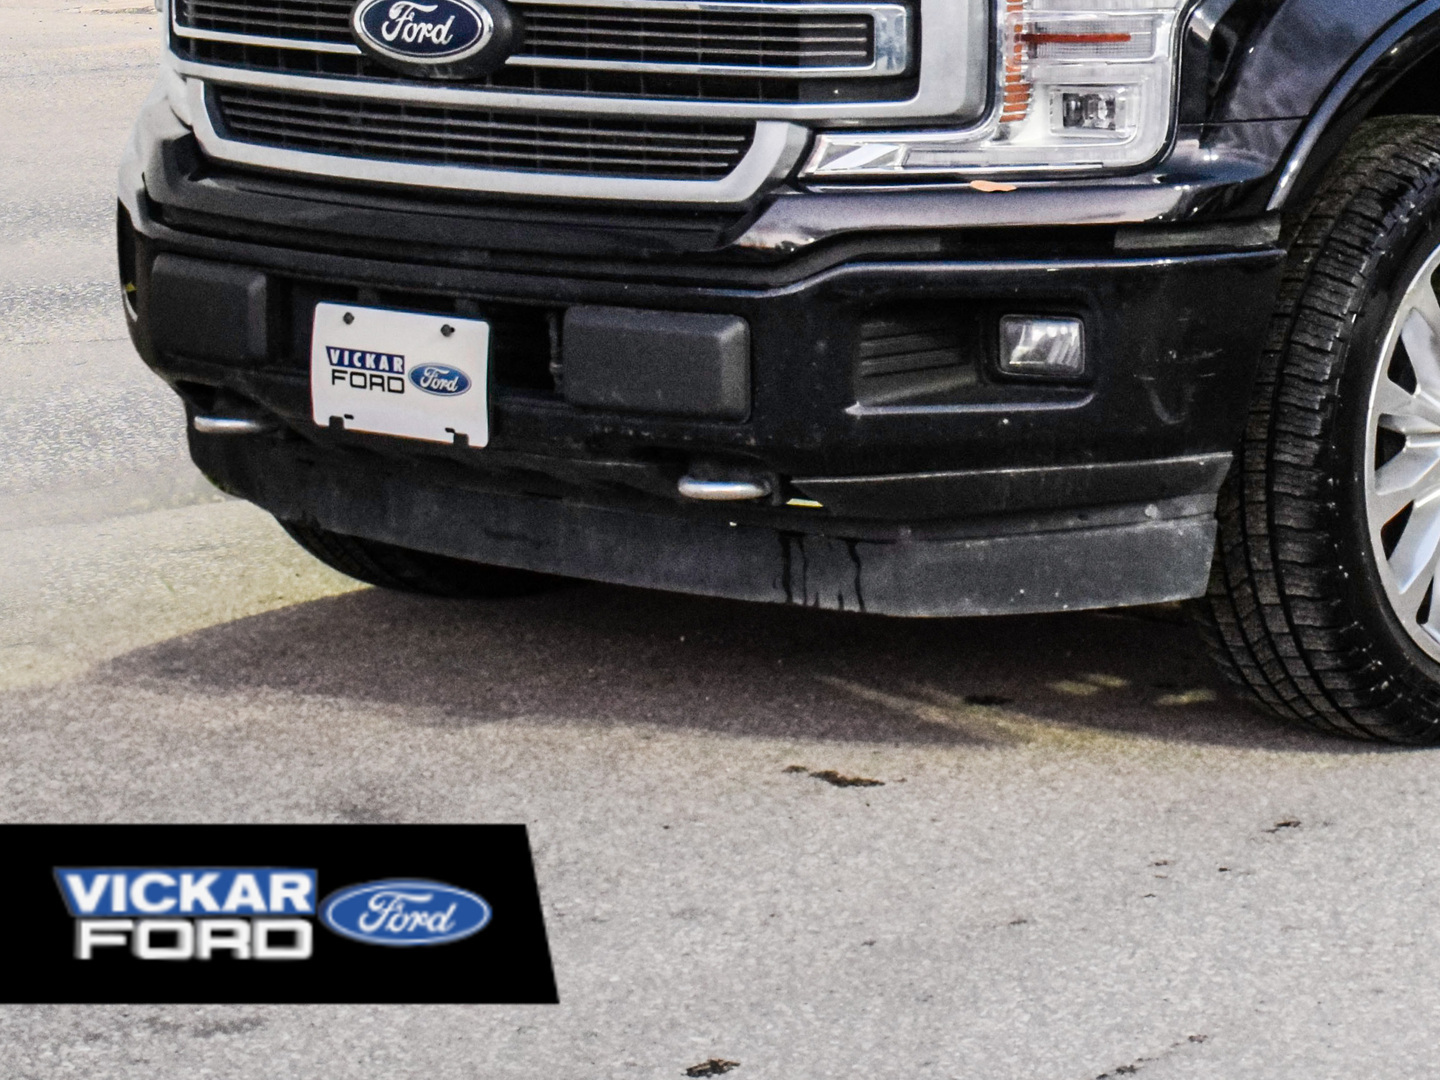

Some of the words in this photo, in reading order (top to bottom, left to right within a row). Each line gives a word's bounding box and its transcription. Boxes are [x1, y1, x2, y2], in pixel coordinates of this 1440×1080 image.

[381, 0, 456, 46] Ford
[329, 348, 405, 373] VICKAR
[331, 368, 405, 394] FORD
[419, 366, 459, 392] Ford
